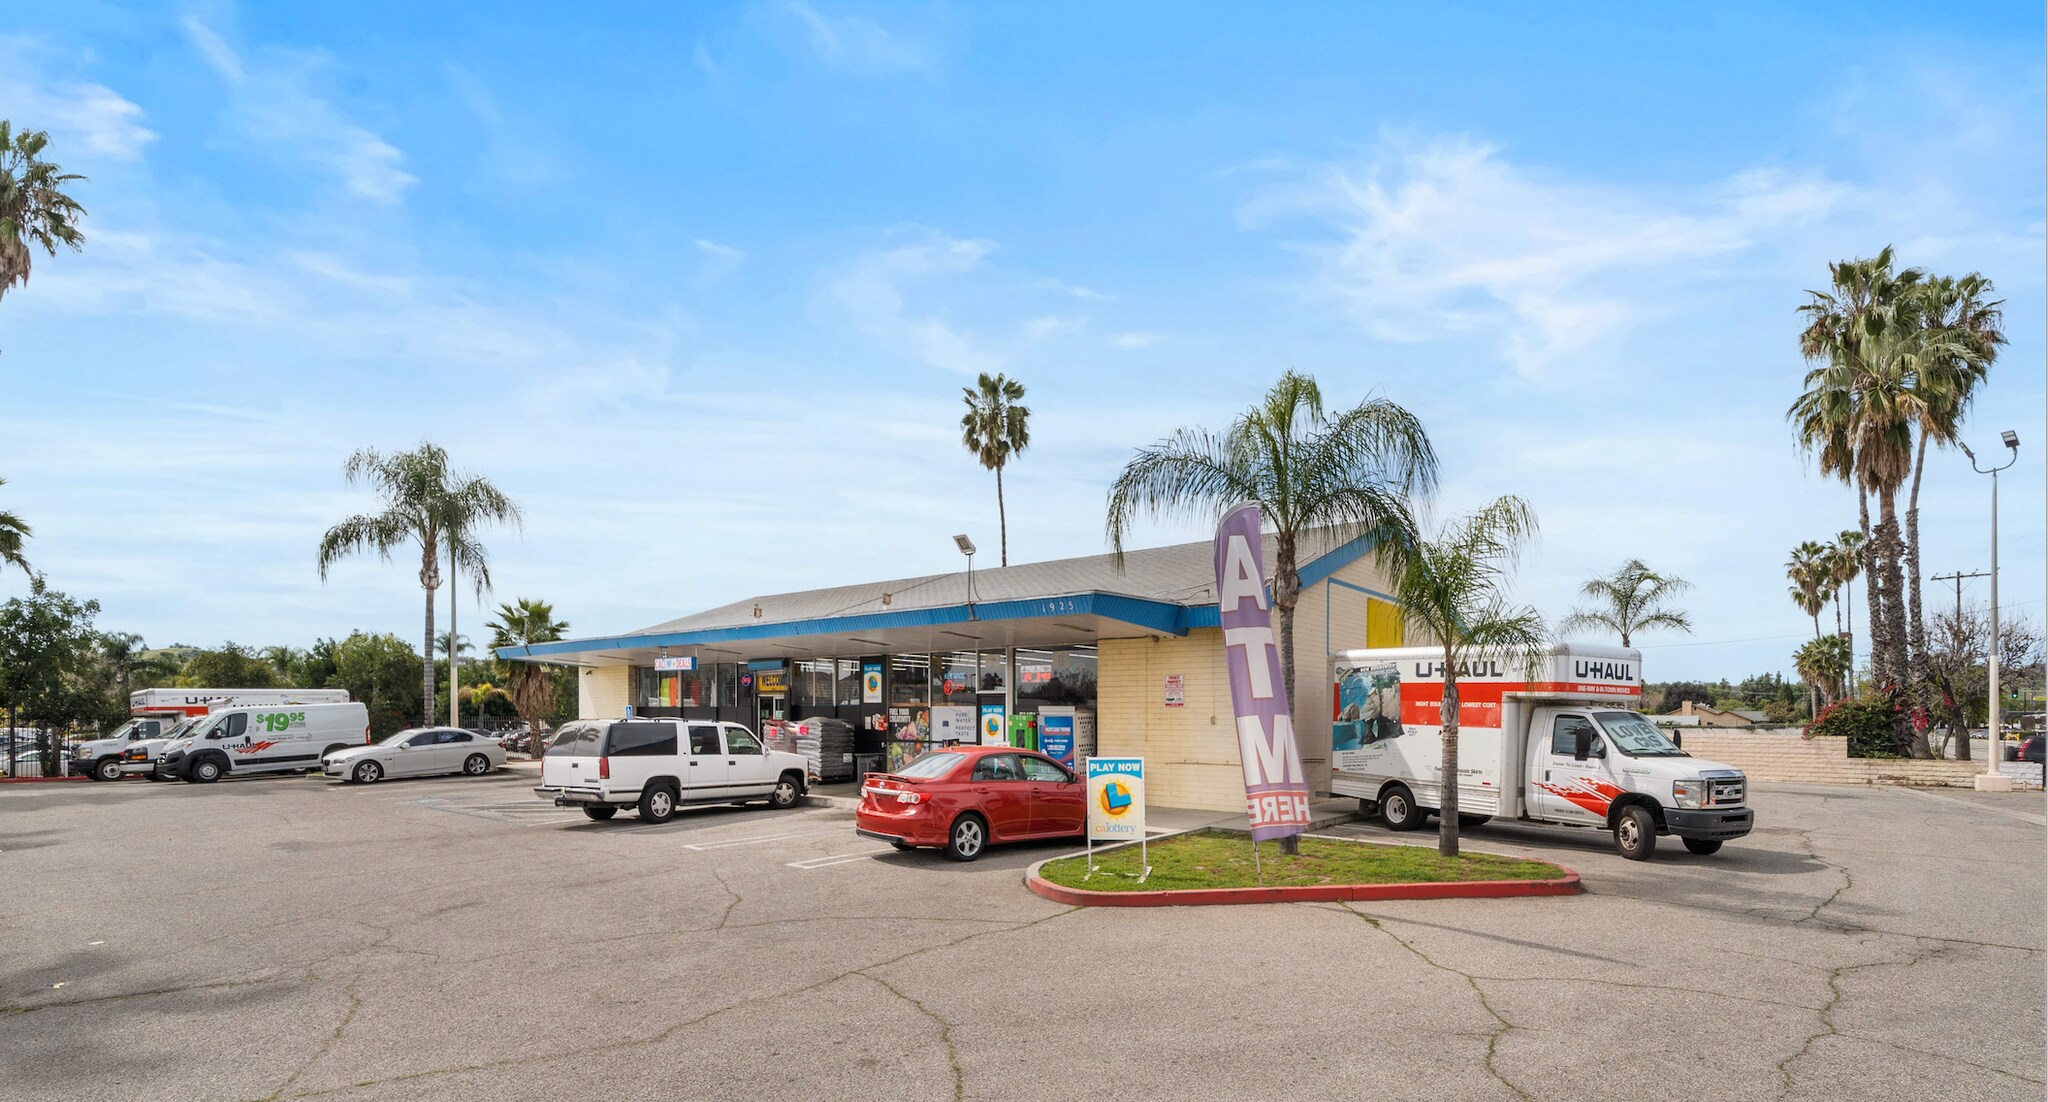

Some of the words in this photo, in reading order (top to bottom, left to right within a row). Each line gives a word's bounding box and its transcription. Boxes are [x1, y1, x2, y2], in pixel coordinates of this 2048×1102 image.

[1042, 601, 1074, 613] 1925
[1221, 535, 1305, 786] ATM
[1575, 660, 1634, 681] U-HAUL
[1610, 722, 1651, 739] LOWE
[1633, 735, 1663, 748] COS
[1090, 763, 1115, 772] PLAY
[1117, 763, 1141, 772] NOW
[1095, 822, 1136, 835] calottery
